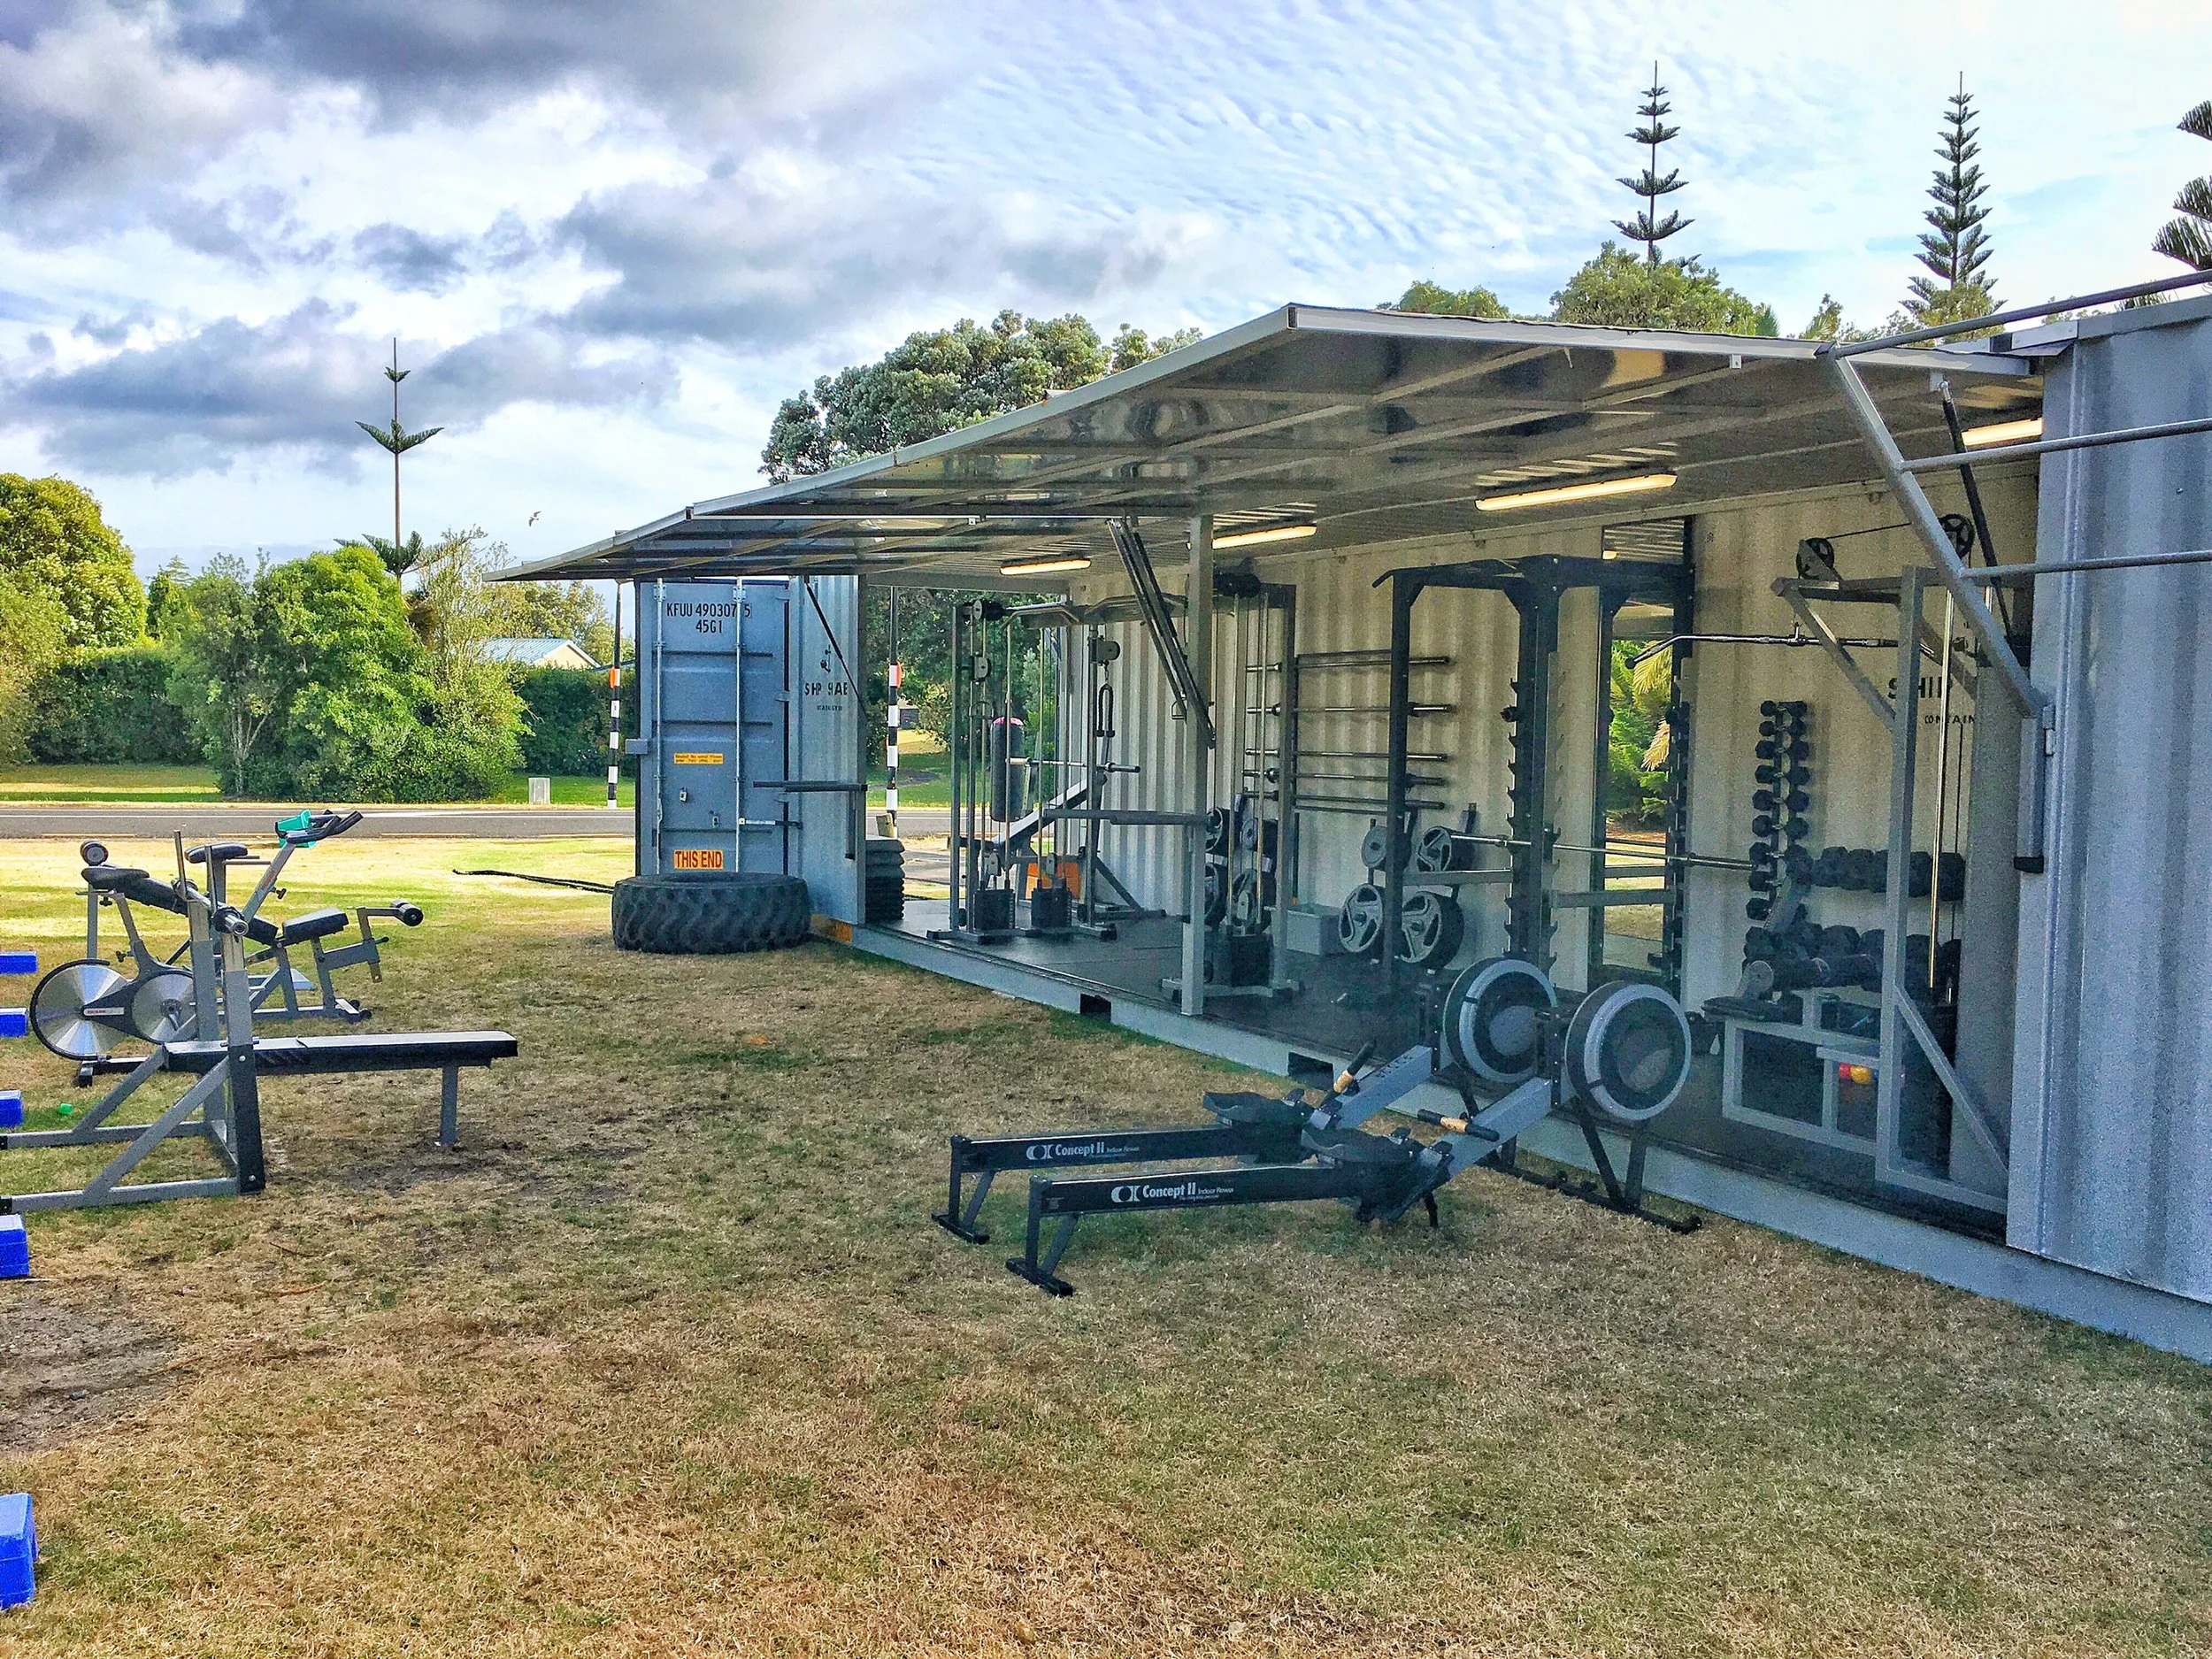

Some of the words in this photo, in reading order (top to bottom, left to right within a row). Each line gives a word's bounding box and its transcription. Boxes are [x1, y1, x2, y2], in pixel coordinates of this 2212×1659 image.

[666, 603, 693, 617] KFUU
[695, 619, 723, 634] 45G1
[674, 850, 699, 868] THIS
[701, 850, 723, 868] END
[1055, 1143, 1095, 1157] Concept
[1096, 1141, 1105, 1154] II
[1142, 1184, 1186, 1199] Concept
[1187, 1182, 1196, 1195] II
